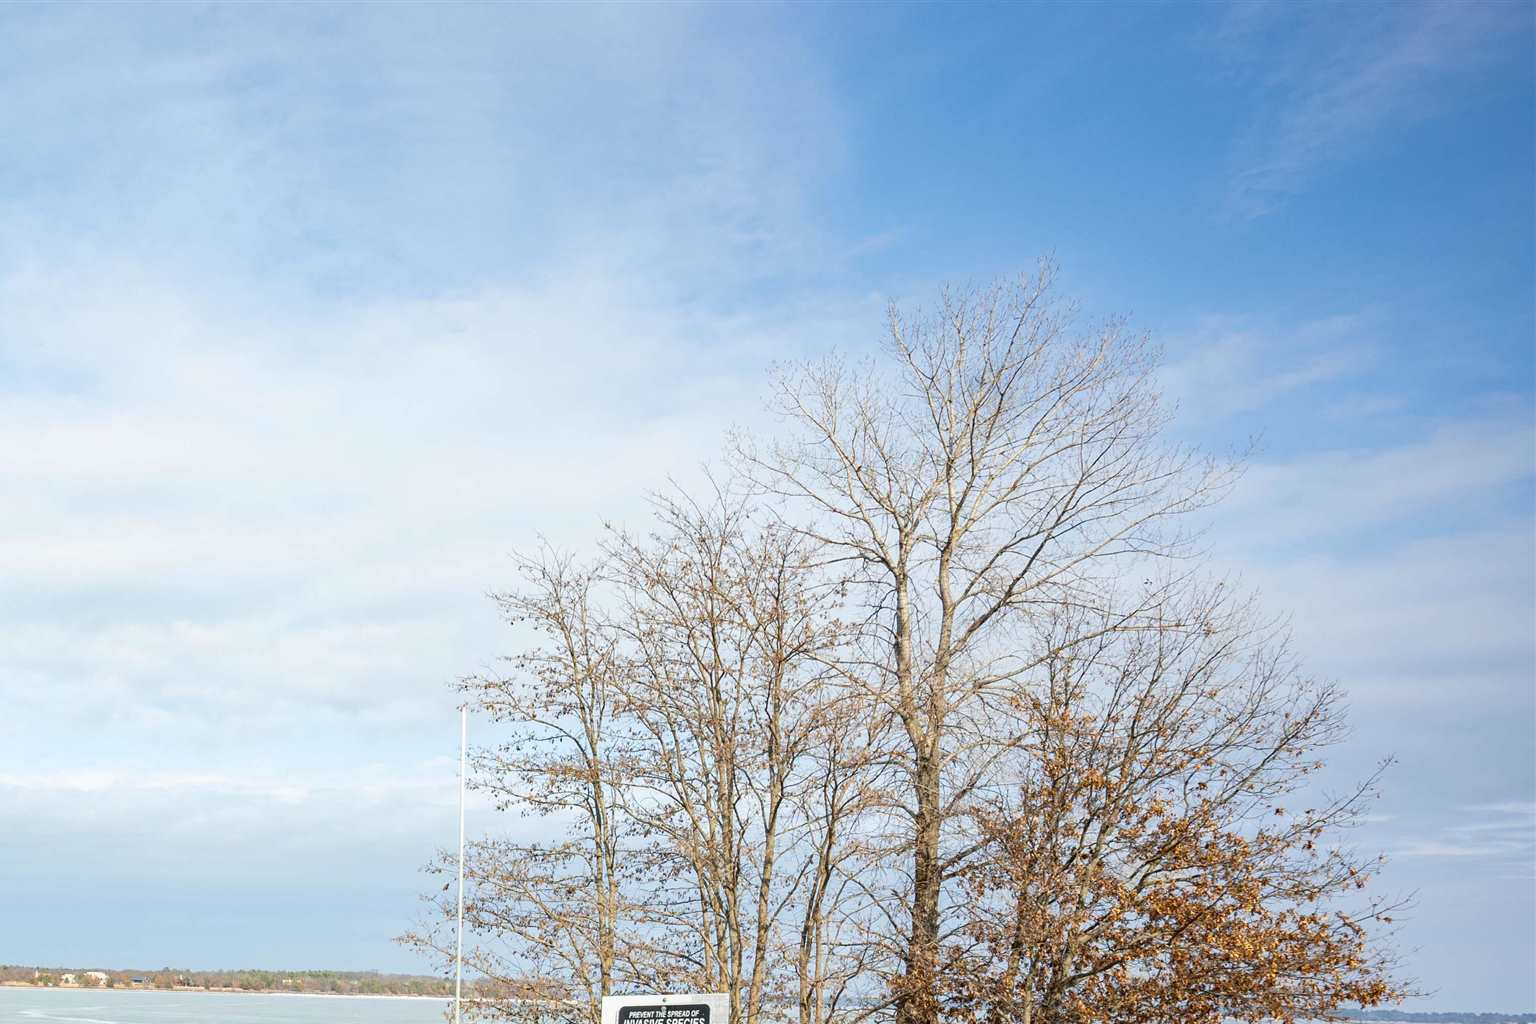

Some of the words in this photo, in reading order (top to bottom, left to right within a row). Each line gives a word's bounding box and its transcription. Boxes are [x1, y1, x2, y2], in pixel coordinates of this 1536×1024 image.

[629, 1010, 655, 1019] PREVENT
[656, 1010, 666, 1018] THE
[667, 1010, 691, 1018] SPREAD
[691, 1009, 700, 1017] OF
